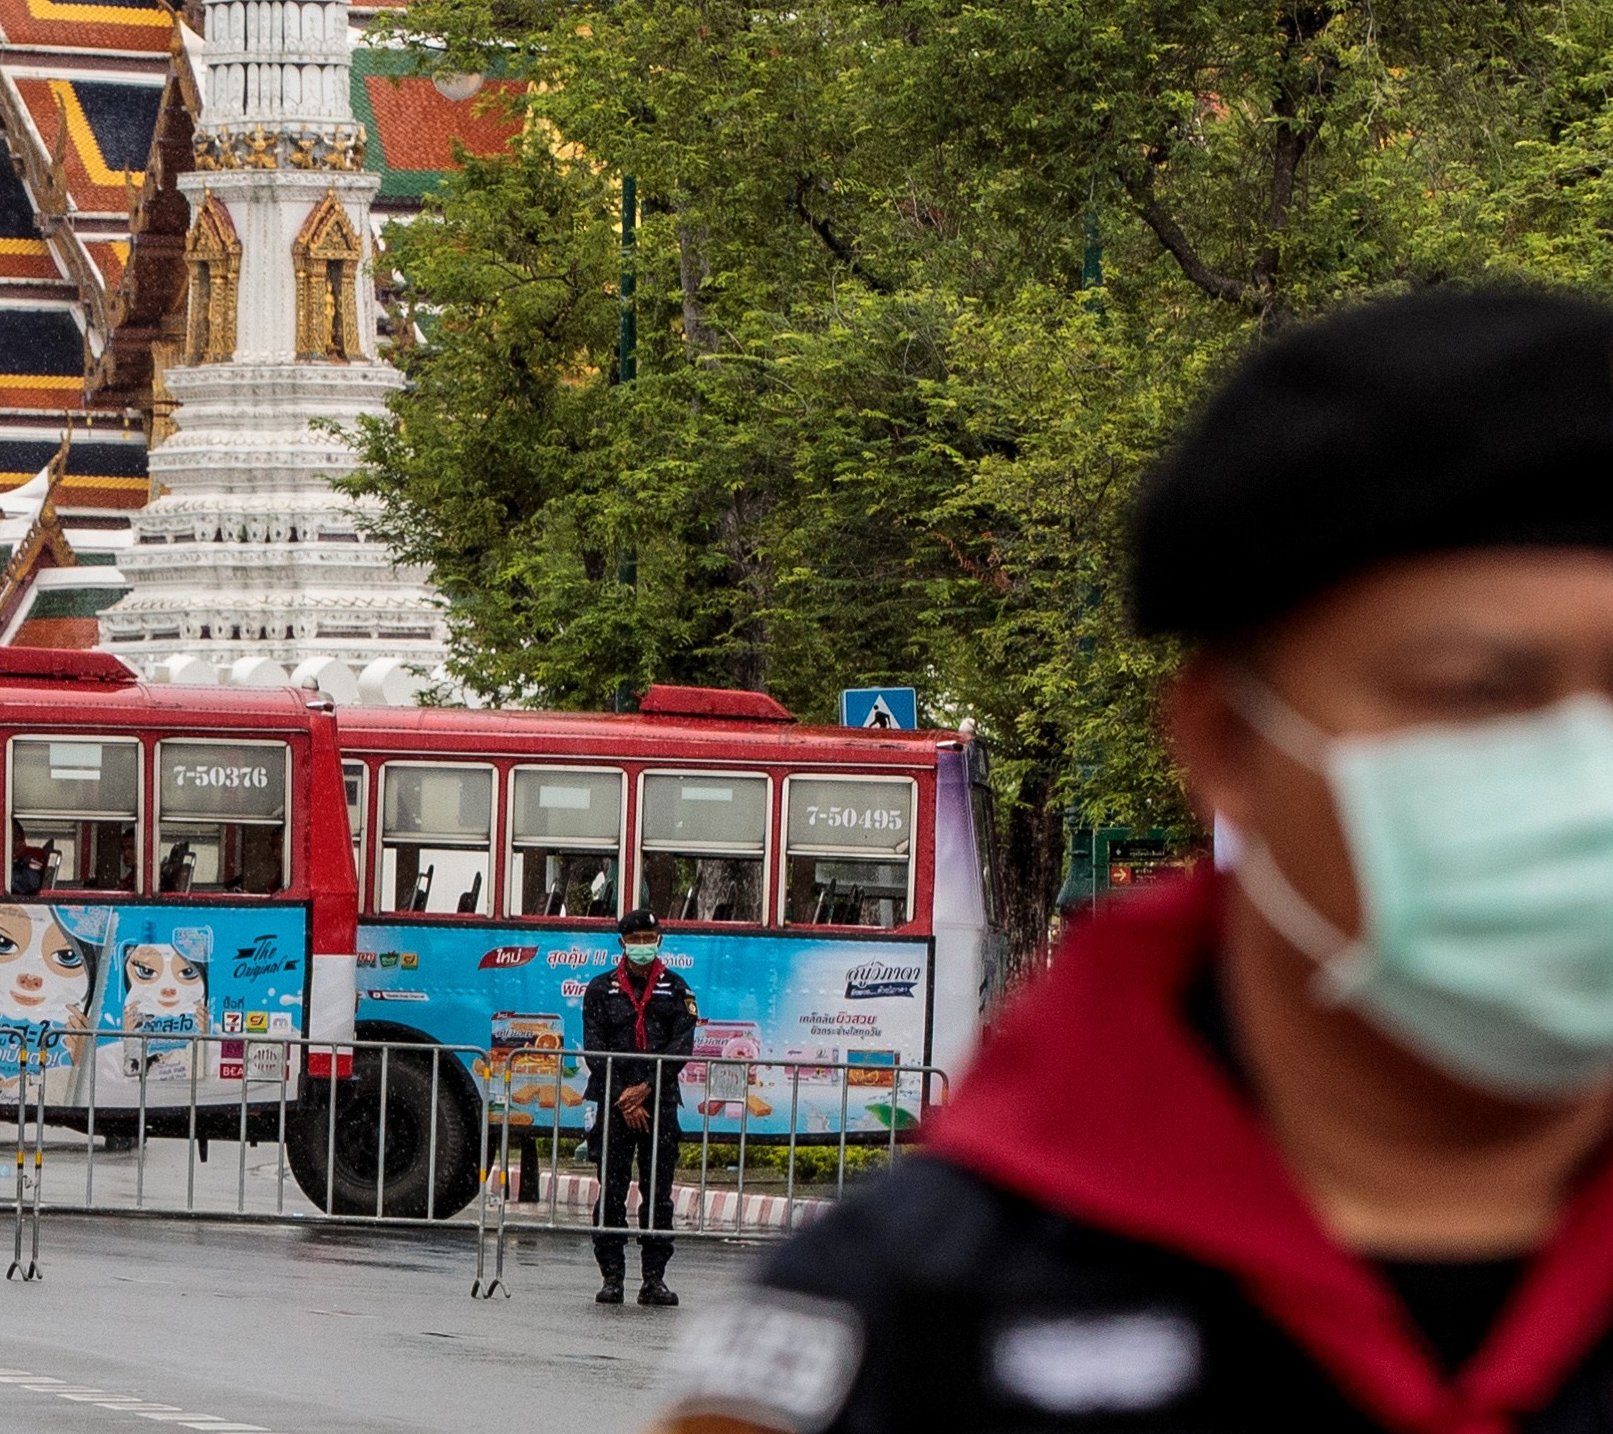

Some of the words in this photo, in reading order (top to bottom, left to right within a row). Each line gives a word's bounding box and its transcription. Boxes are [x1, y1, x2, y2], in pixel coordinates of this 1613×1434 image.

[173, 765, 268, 788] 7-50376
[806, 806, 903, 830] 7-50495
[254, 934, 278, 962] The
[496, 948, 523, 964] ใหม่
[547, 948, 589, 969] สุดคุ้ม
